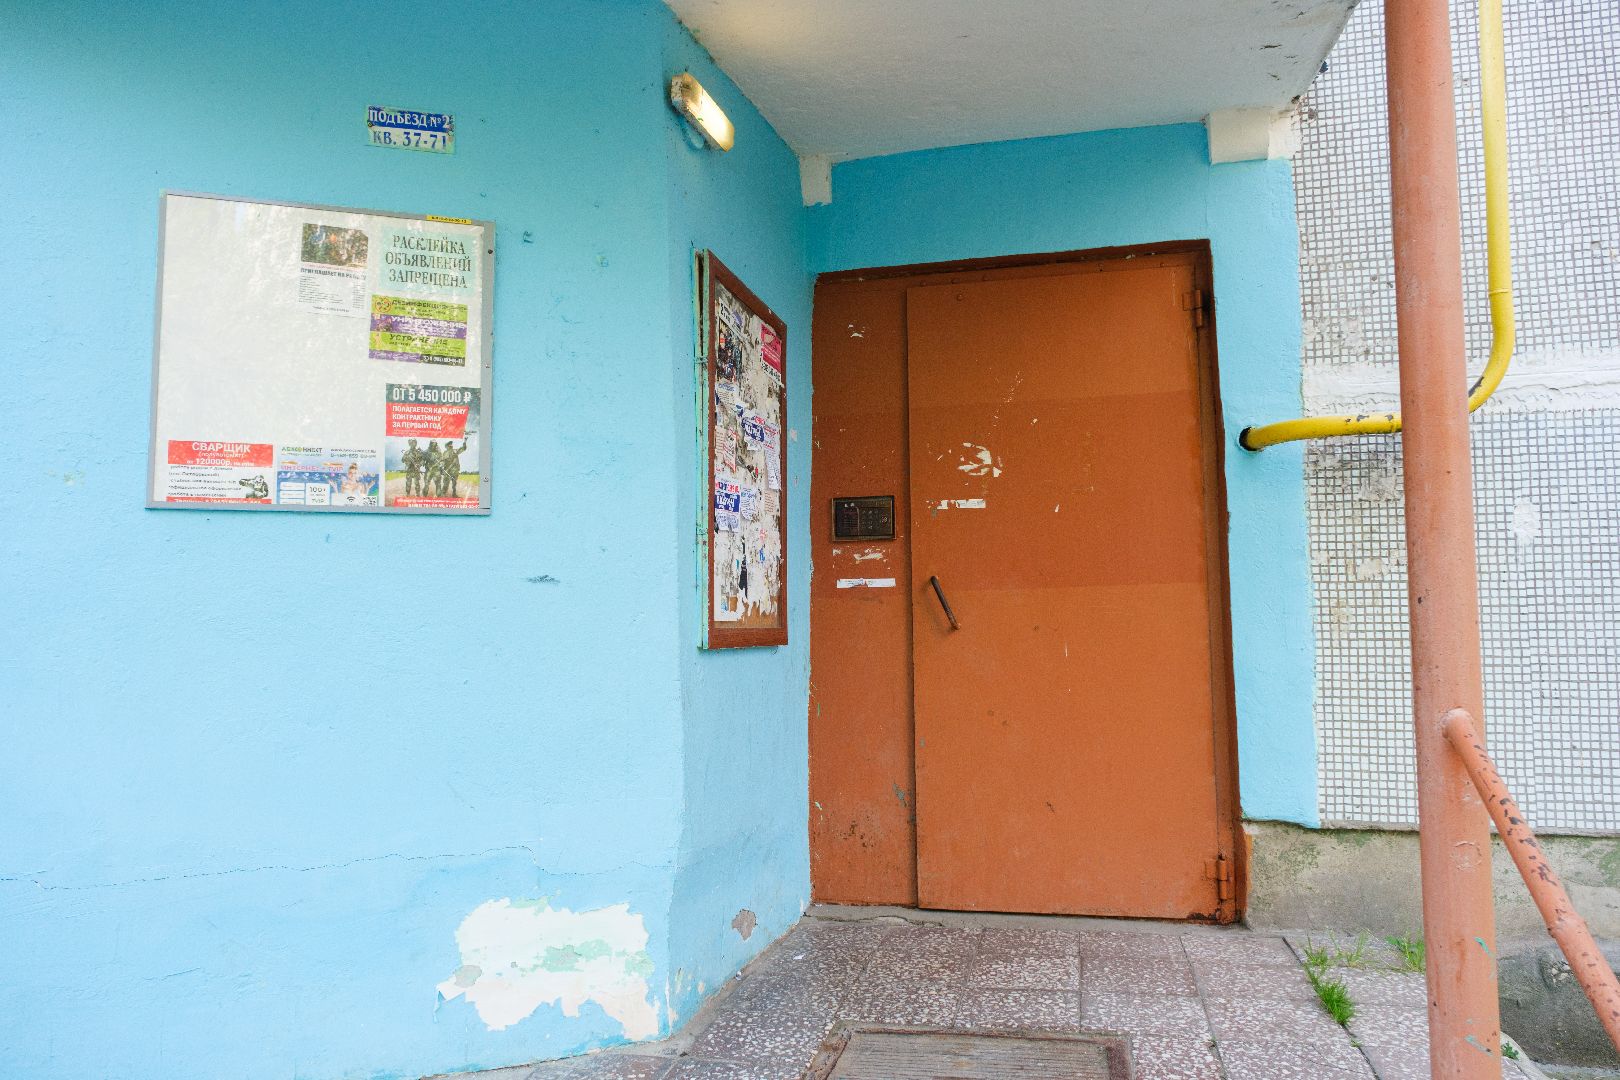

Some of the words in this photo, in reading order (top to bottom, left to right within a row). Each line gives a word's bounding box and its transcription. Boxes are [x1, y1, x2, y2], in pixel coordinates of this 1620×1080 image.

[368, 109, 427, 128] ПОДЪЕЗД
[402, 131, 447, 150] 37-71
[392, 234, 466, 254] РАСКЛЕЙКА
[385, 251, 472, 272] ОБЪЯВЛЕНИЙ
[389, 268, 468, 288] ЗАПРЕЩЕНА
[392, 387, 406, 401] ОТ
[408, 388, 416, 401] 5
[418, 389, 439, 402] 450
[441, 389, 462, 403] 000
[392, 405, 433, 414] ПОЛАГАЕТСЯ
[433, 407, 466, 415] КАЖДОМУ
[392, 413, 442, 422] КОНТРАКТНИКУ
[401, 421, 429, 429] ПЕРВЫЙ
[429, 422, 442, 430] ГОД
[191, 441, 251, 454] СВАРЩИК
